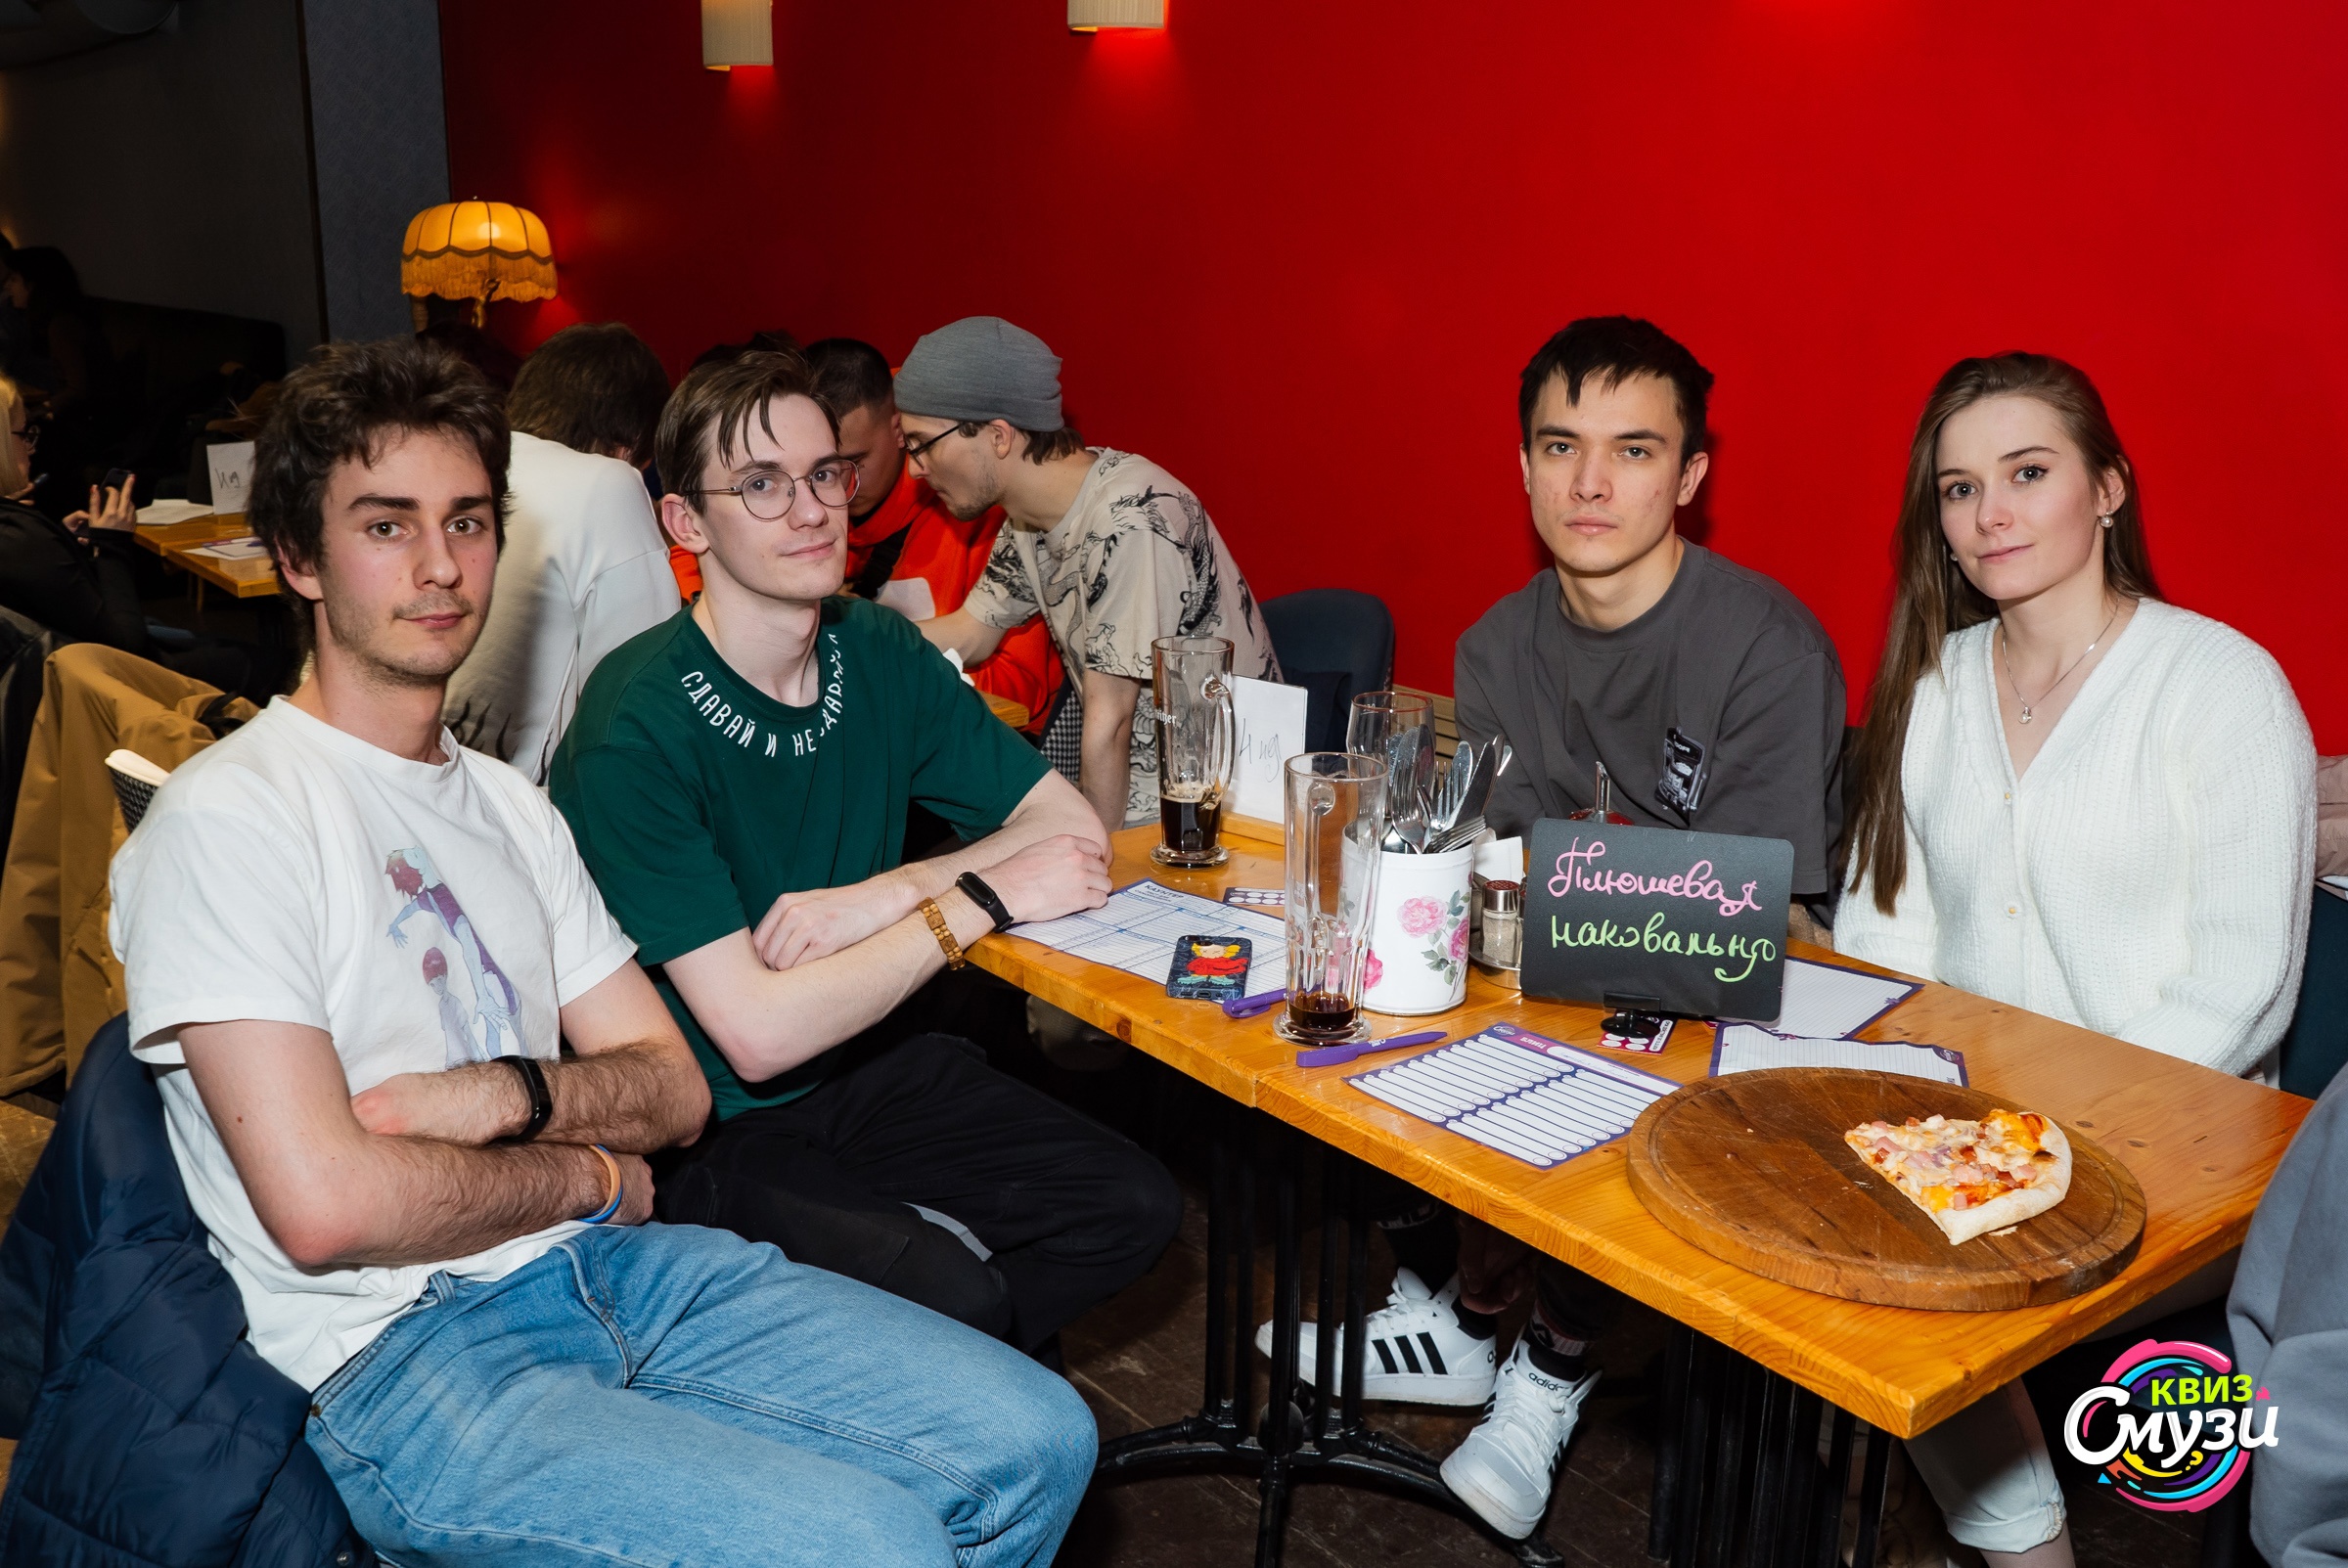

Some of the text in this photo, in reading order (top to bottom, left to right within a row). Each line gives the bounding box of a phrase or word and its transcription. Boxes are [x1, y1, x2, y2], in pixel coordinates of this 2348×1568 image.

[681, 670, 756, 748] СДАВАЙ
[764, 733, 778, 758] И
[791, 729, 817, 757] НЕ
[1547, 836, 1763, 917] Плюшевая
